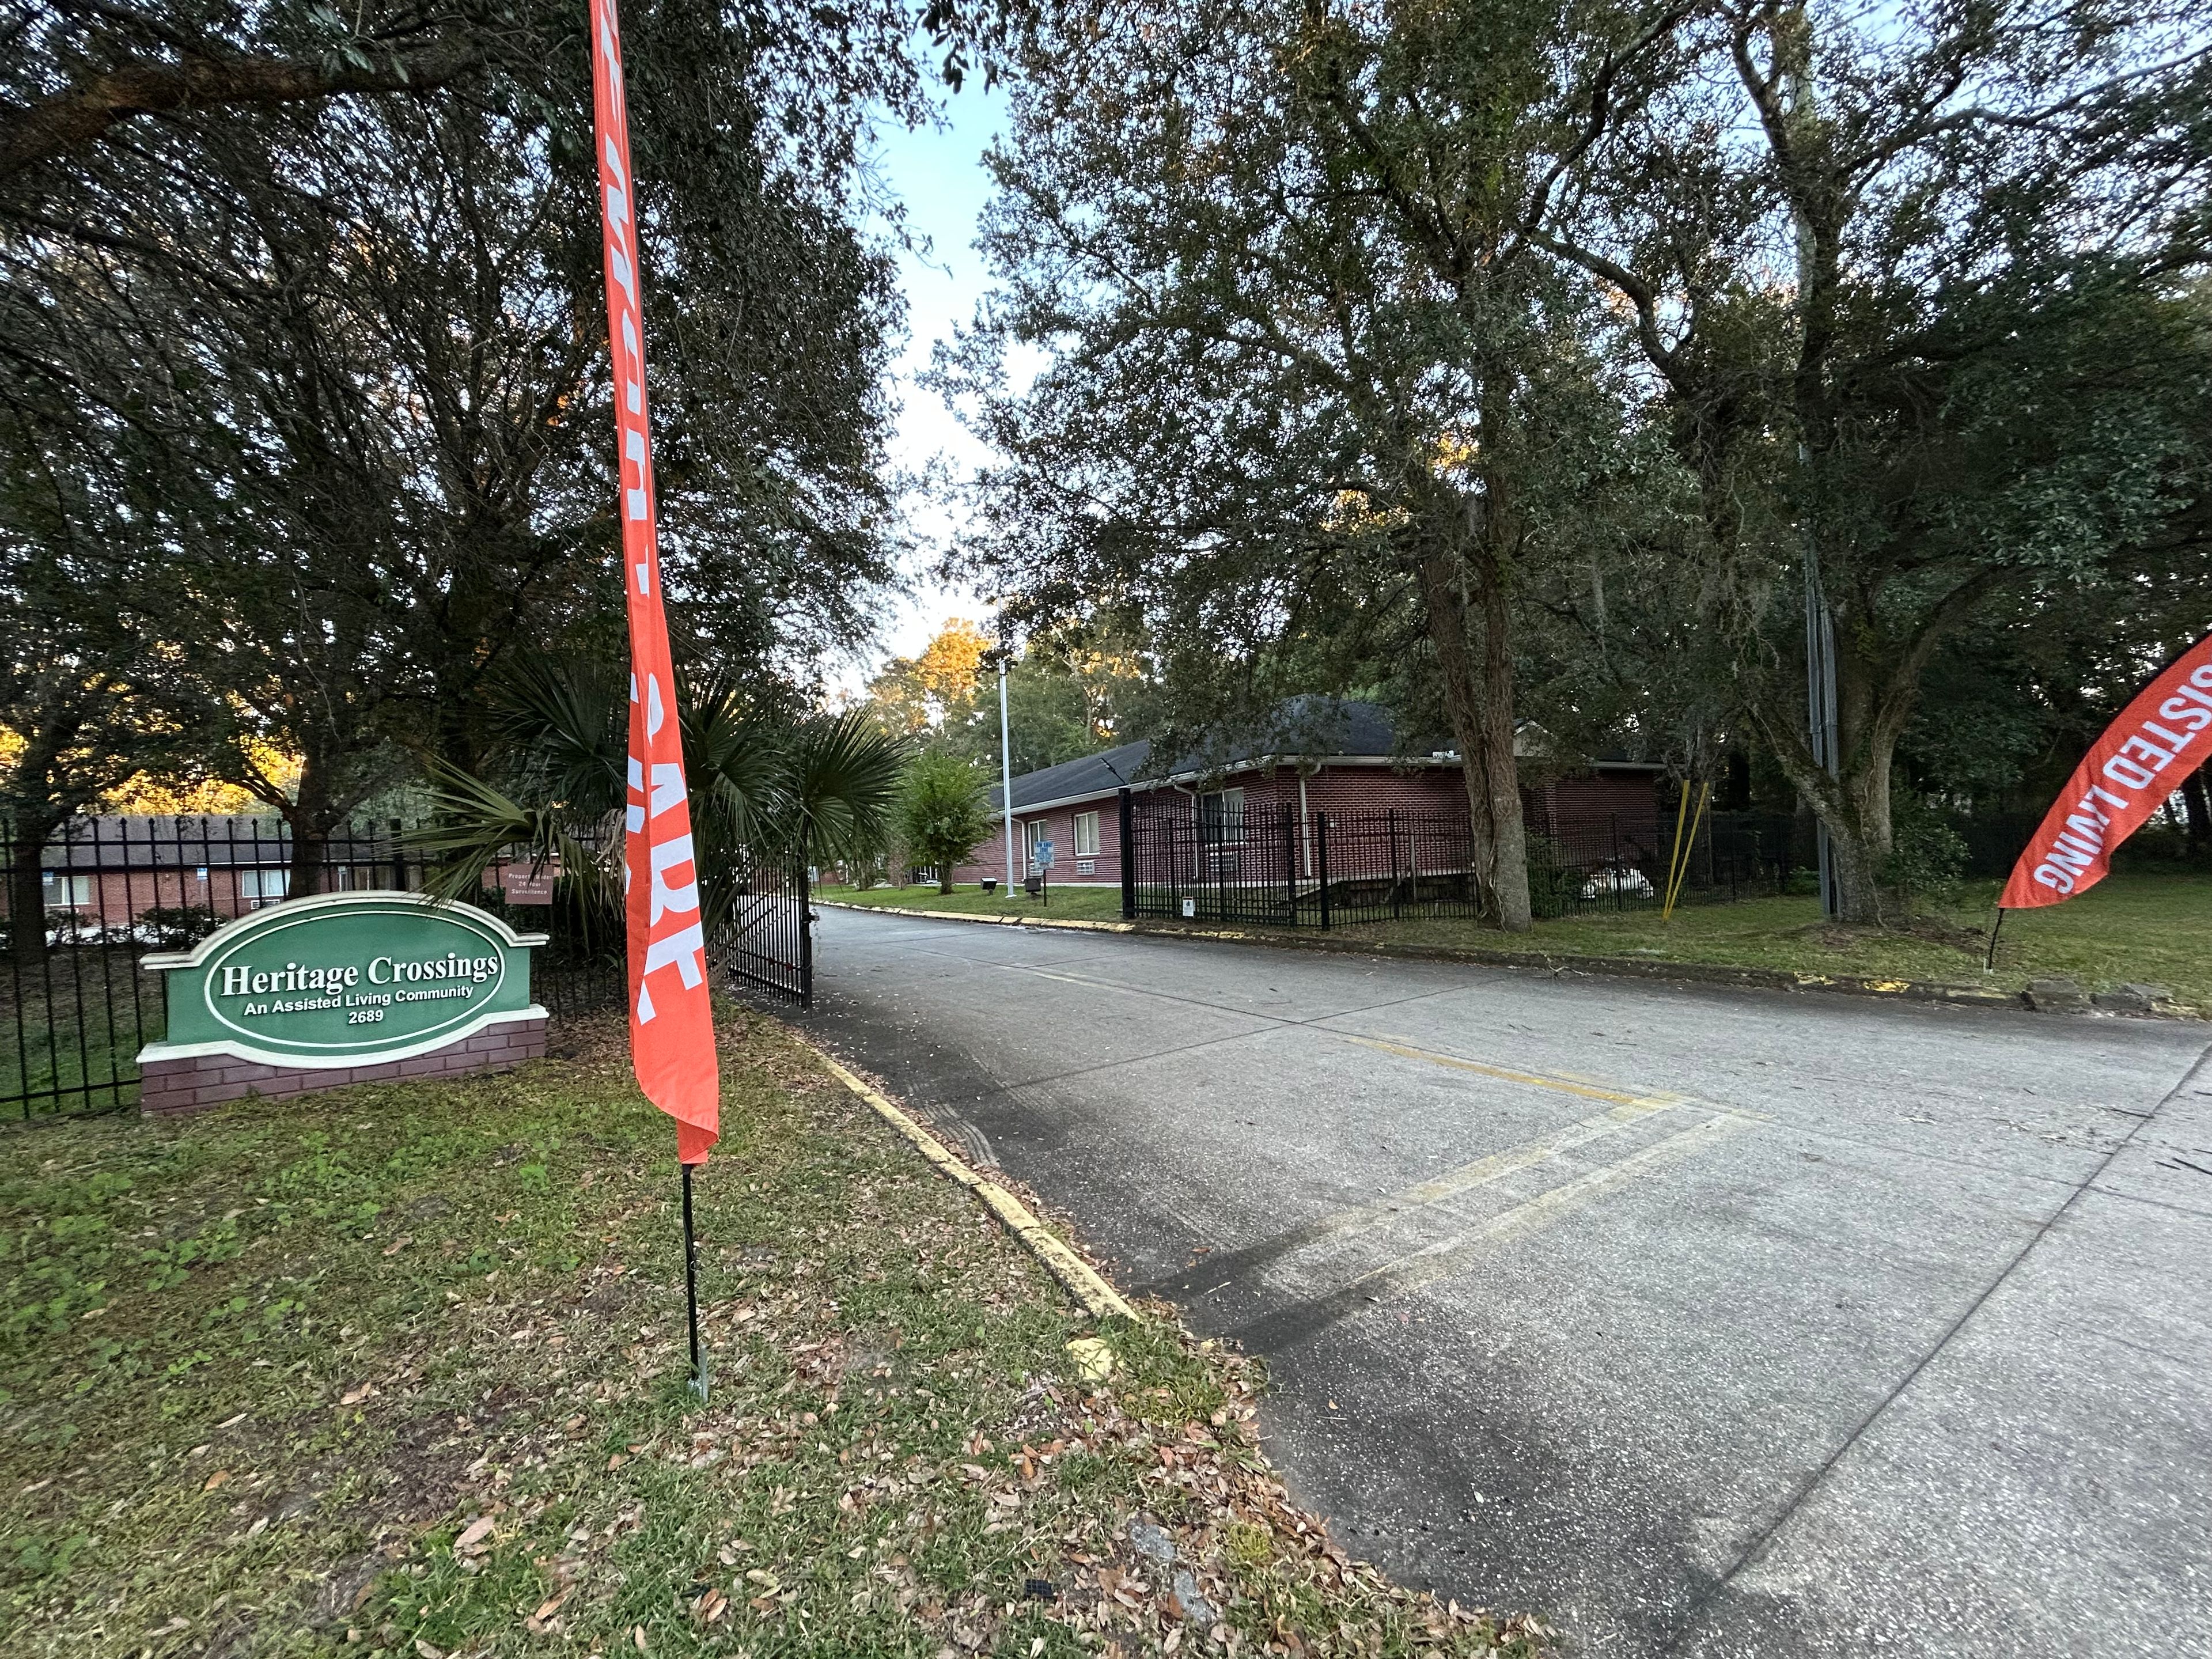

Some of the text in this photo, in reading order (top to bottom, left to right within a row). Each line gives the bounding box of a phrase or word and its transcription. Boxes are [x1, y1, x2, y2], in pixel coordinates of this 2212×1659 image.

[220, 952, 499, 996] Heritage Crossings
[244, 985, 474, 1016] An Assisted Living Community
[349, 1010, 384, 1024] 2689
